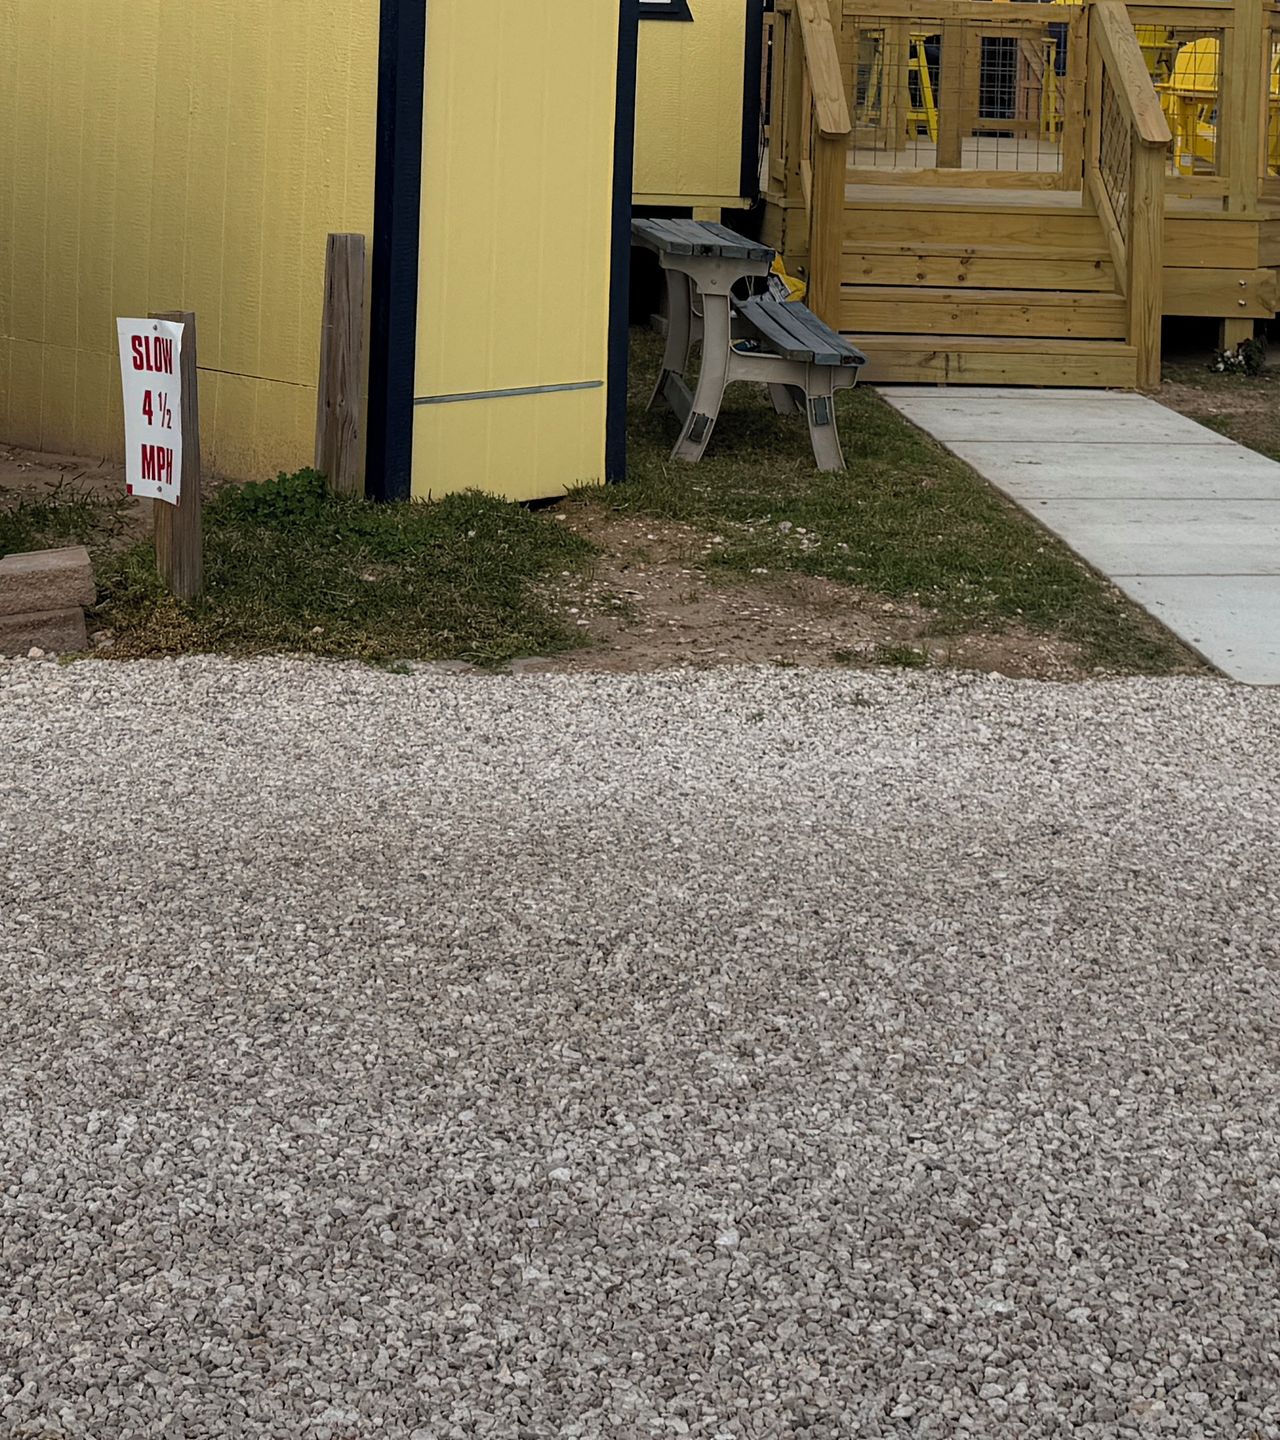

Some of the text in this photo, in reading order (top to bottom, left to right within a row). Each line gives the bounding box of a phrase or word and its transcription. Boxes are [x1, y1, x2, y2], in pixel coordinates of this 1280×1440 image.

[131, 335, 173, 375] SLOW
[142, 390, 154, 426] 4
[141, 444, 173, 485] MPH
